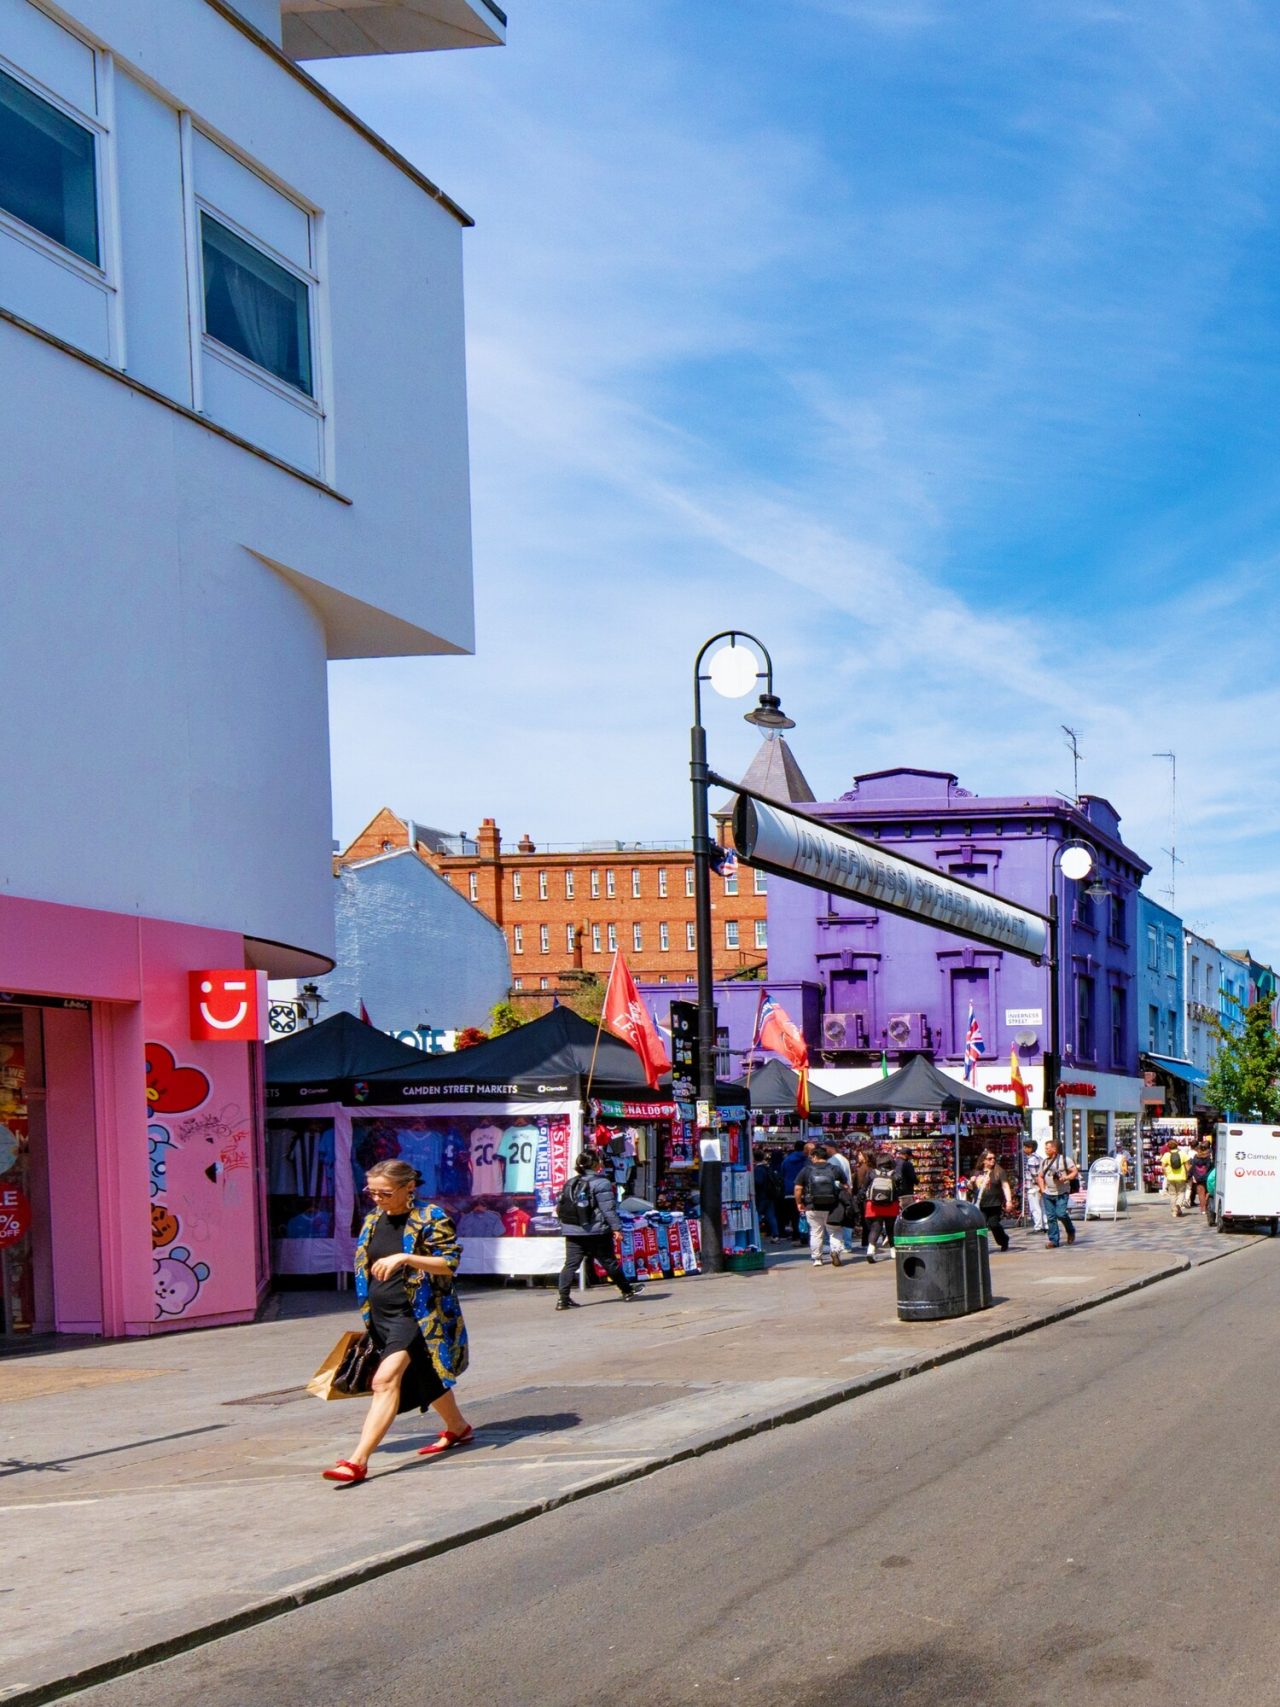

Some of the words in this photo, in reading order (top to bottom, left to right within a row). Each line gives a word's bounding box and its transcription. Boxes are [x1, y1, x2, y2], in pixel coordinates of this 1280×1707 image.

[801, 830, 908, 895] INVERNESS
[915, 876, 971, 918] STREET
[974, 899, 1026, 938] MARKET
[402, 1086, 441, 1096] CAMDEN
[443, 1084, 475, 1094] STREET
[476, 1084, 519, 1094] MARKETS
[508, 1142, 533, 1165] 20
[552, 1130, 565, 1184] SAKA
[0, 1190, 19, 1206] E
